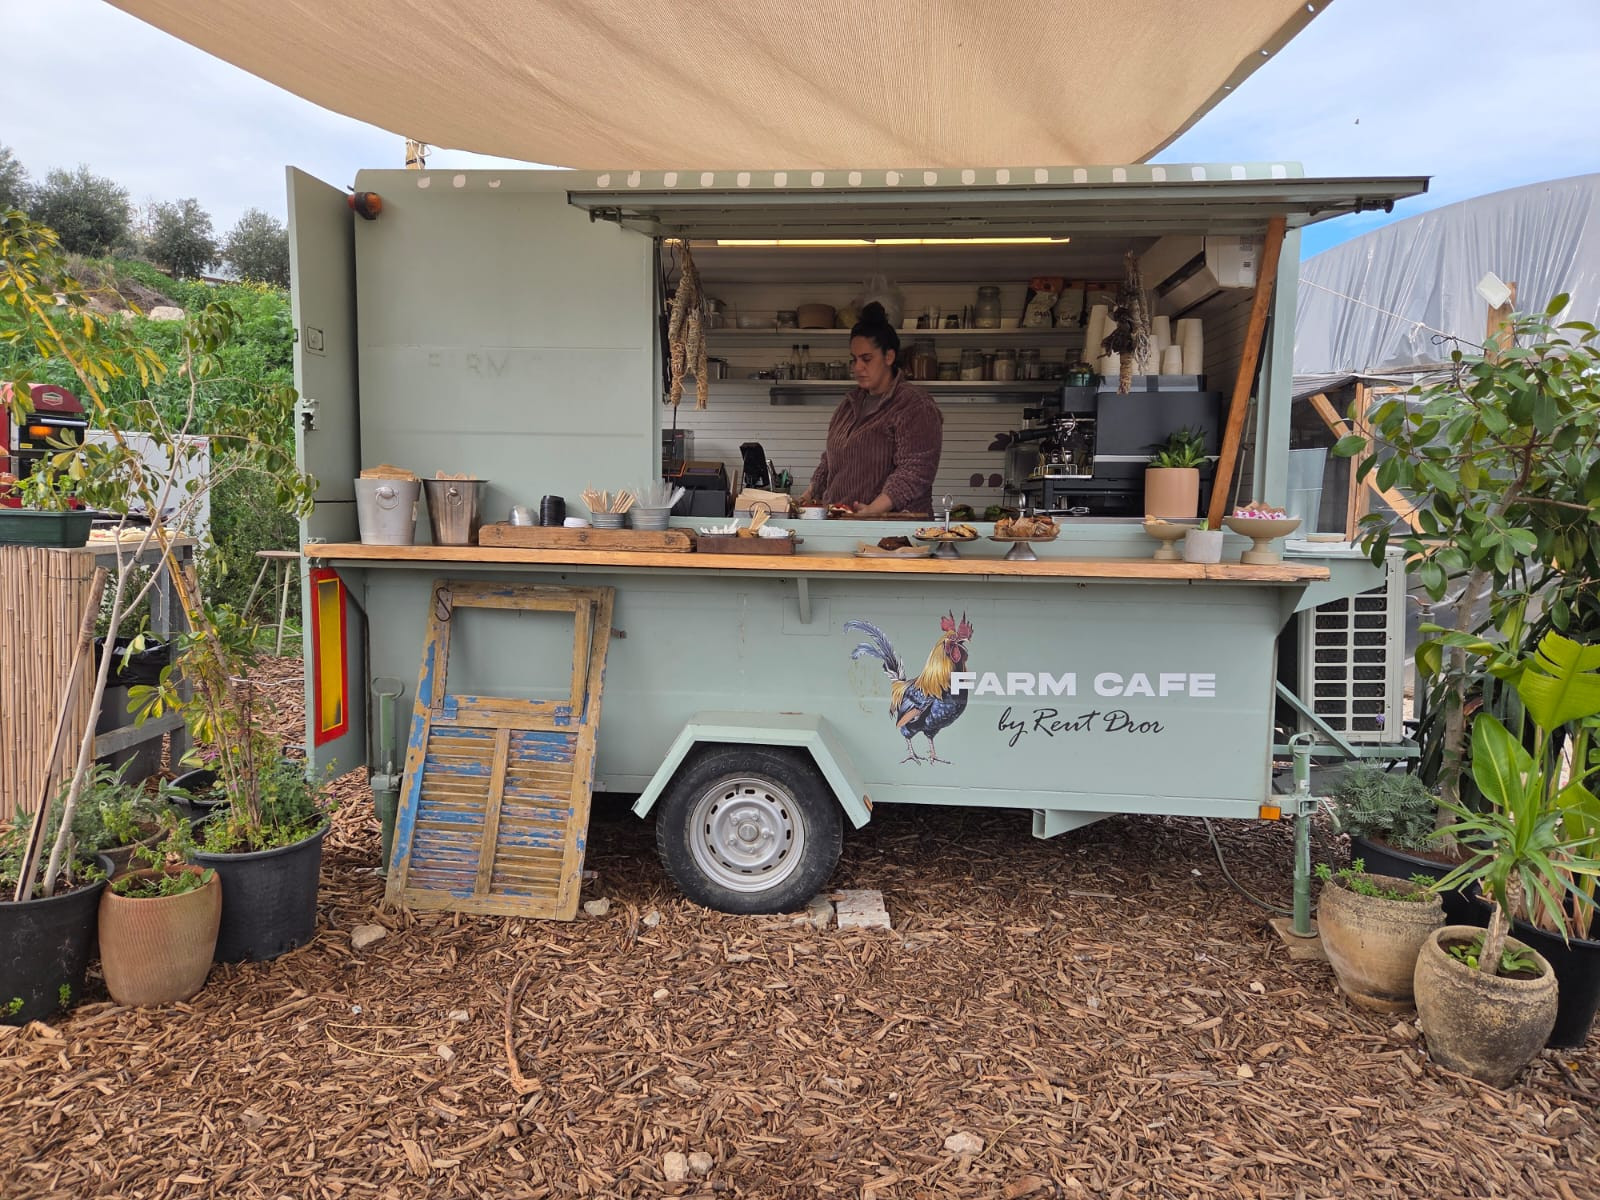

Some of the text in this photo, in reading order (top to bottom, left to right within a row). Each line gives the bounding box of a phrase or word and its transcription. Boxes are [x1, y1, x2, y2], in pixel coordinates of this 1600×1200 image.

[950, 672, 1216, 697] FARM CAFE
[998, 707, 1028, 747] by
[1103, 709, 1164, 733] Dror
